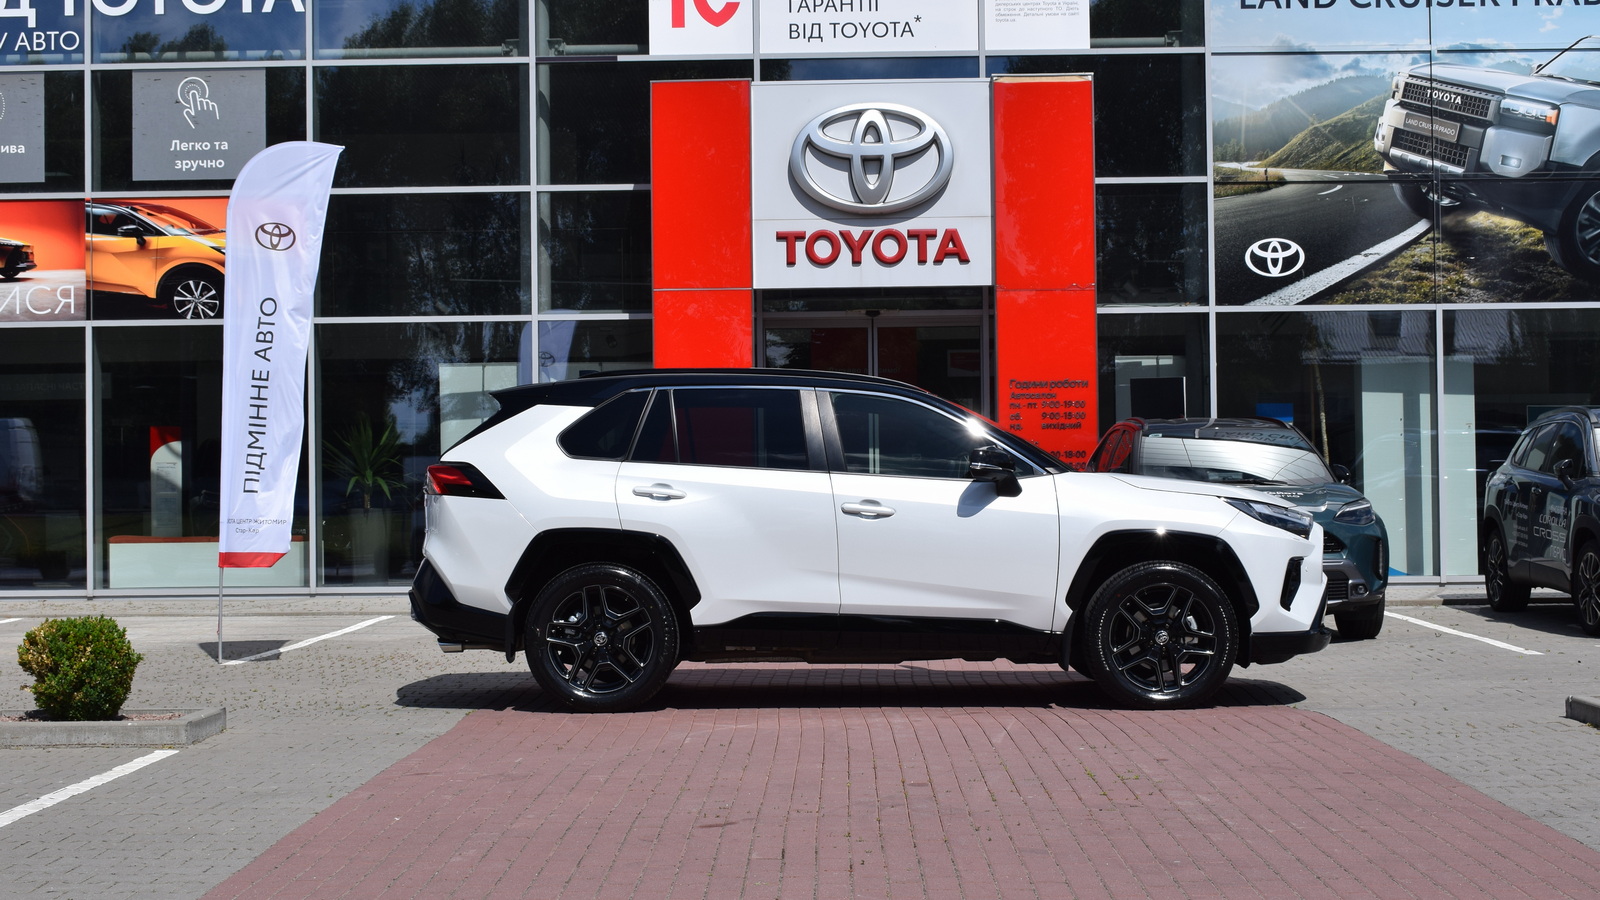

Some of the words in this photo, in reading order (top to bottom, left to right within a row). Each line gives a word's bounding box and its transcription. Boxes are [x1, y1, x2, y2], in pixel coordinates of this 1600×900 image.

[15, 31, 80, 51] АВТО
[789, 23, 823, 43] ВІД
[1427, 89, 1461, 104] TOYOTA
[1406, 118, 1418, 126] LAND
[1439, 125, 1455, 135] PRADO
[170, 140, 211, 151] Легко
[214, 142, 228, 150] та
[175, 159, 225, 171] зручно
[776, 229, 970, 266] TOYOTA
[254, 297, 277, 362] АВТО
[1010, 379, 1048, 389] Години
[1050, 378, 1088, 390] роботи
[243, 370, 270, 493] ПІДМІННЕ
[1042, 421, 1081, 430] вихідний
[1534, 526, 1566, 543] CROSS
